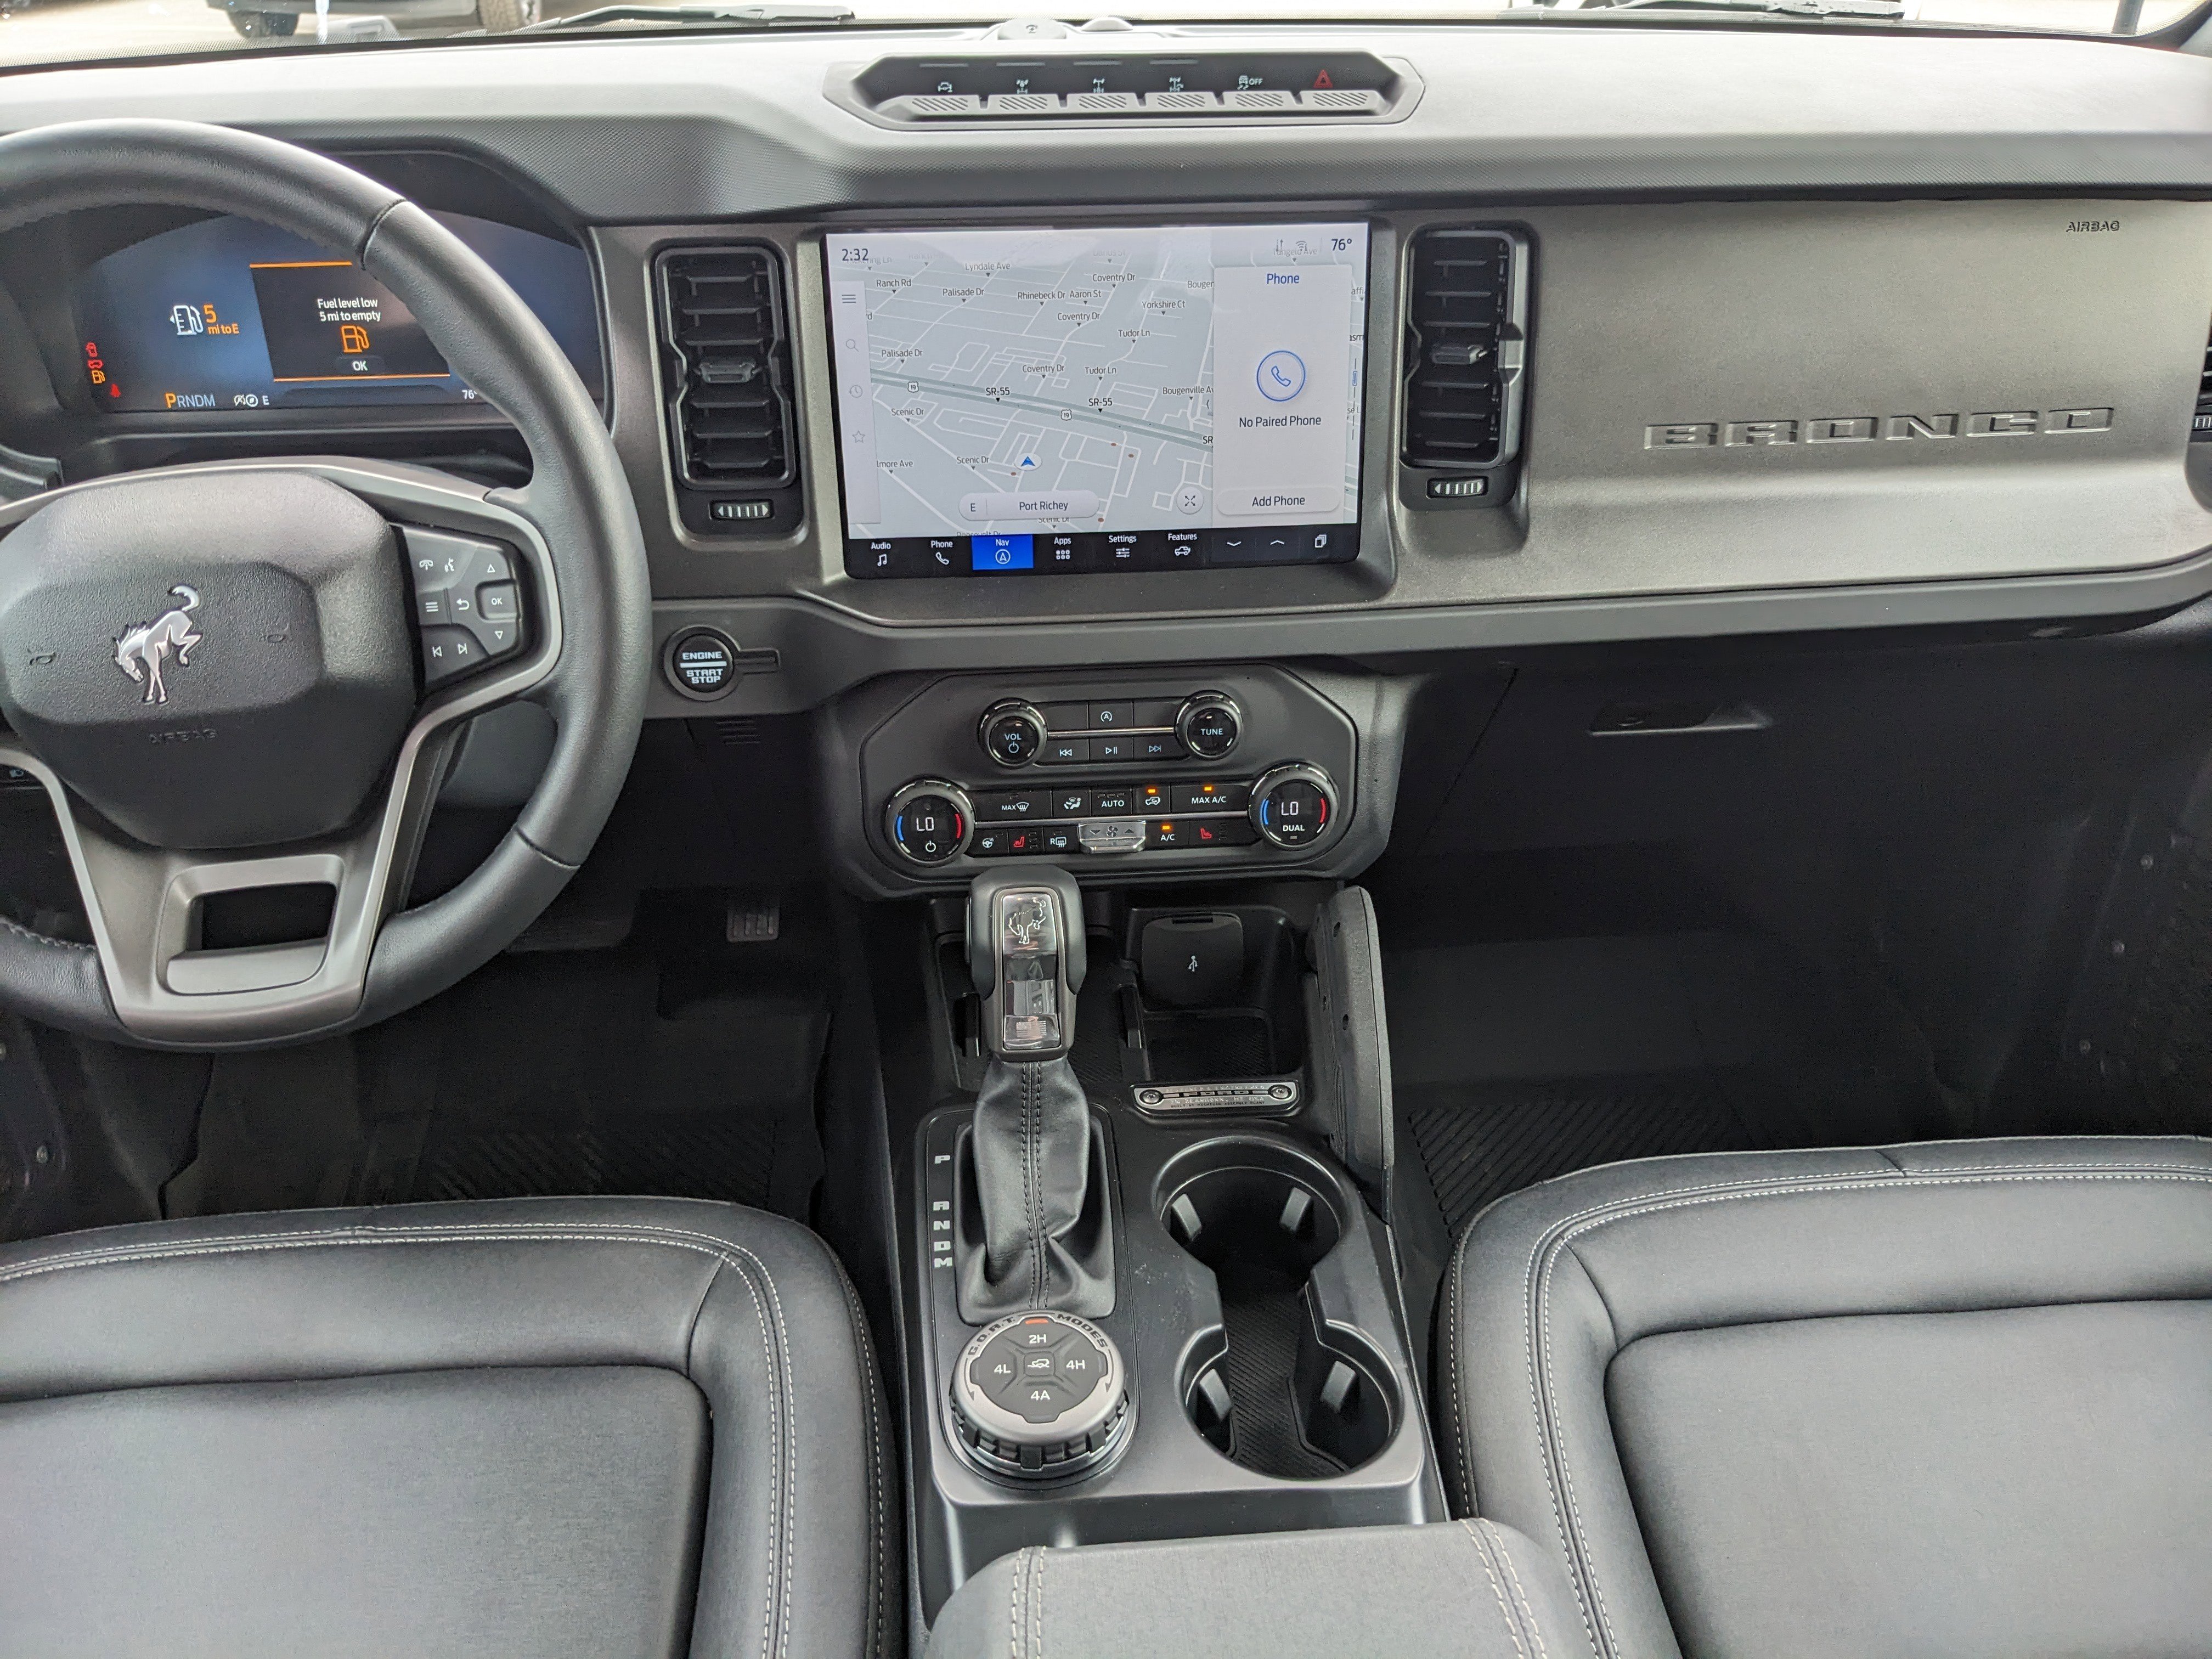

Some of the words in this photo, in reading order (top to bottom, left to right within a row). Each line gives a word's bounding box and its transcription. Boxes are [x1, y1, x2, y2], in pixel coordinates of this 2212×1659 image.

[2066, 221, 2120, 232] AIRBAG
[1331, 238, 1352, 251] 76°
[842, 249, 868, 262] 2:32
[966, 263, 994, 271] Lyndale
[1092, 275, 1125, 283] Coventry
[1267, 273, 1300, 284] Phone
[943, 288, 974, 296] Palisade
[318, 298, 337, 309] Fuel
[339, 297, 360, 308] level
[362, 297, 378, 308] low
[203, 304, 217, 323] 5
[320, 312, 326, 321] 5
[328, 311, 340, 321] mi
[341, 311, 351, 320] to
[352, 311, 381, 322] empty
[1057, 313, 1090, 321] Coventry
[208, 325, 220, 335] mi
[221, 324, 231, 334] to
[232, 324, 240, 334] E
[882, 349, 913, 358] Palisade
[353, 360, 368, 371] OK
[1023, 365, 1055, 374] Coventry
[1085, 366, 1106, 375] Tudor
[986, 388, 1010, 396] SR-55
[1163, 386, 1204, 396] Bougenville
[1088, 398, 1113, 407] SR-55
[1239, 417, 1253, 428] No
[1256, 416, 1287, 427] Paired
[1289, 415, 1321, 426] Phone
[1644, 407, 2114, 450] BRONCO
[957, 456, 979, 464] Scenic
[1019, 502, 1037, 511] Port
[1040, 501, 1068, 511] Richey
[1252, 496, 1271, 507] Add
[1274, 495, 1305, 506] Phone
[970, 503, 976, 511] E
[1054, 537, 1071, 545] Apps
[1109, 535, 1137, 543] Settings
[1168, 533, 1197, 541] Features
[682, 651, 723, 661] ENGINE
[686, 668, 724, 678] START
[691, 676, 721, 684] STOP
[1200, 727, 1223, 736] TUNE
[1005, 733, 1022, 742] VOL
[1101, 799, 1124, 808] AUTO
[1192, 796, 1210, 804] MAX
[1212, 795, 1226, 804] A/C
[1281, 801, 1299, 816] LO
[916, 817, 934, 832] LO
[1161, 833, 1175, 842] A/C
[934, 1155, 951, 1164] P
[934, 1220, 950, 1231] N
[934, 1240, 951, 1251] D
[934, 1257, 953, 1268] M
[967, 1316, 1016, 1356] G.O.A.T.
[1057, 1313, 1108, 1348] MODES
[1029, 1334, 1047, 1344] 2H
[994, 1364, 1011, 1374] 4L
[1066, 1360, 1086, 1370] 4H
[1030, 1390, 1051, 1401] 4A
